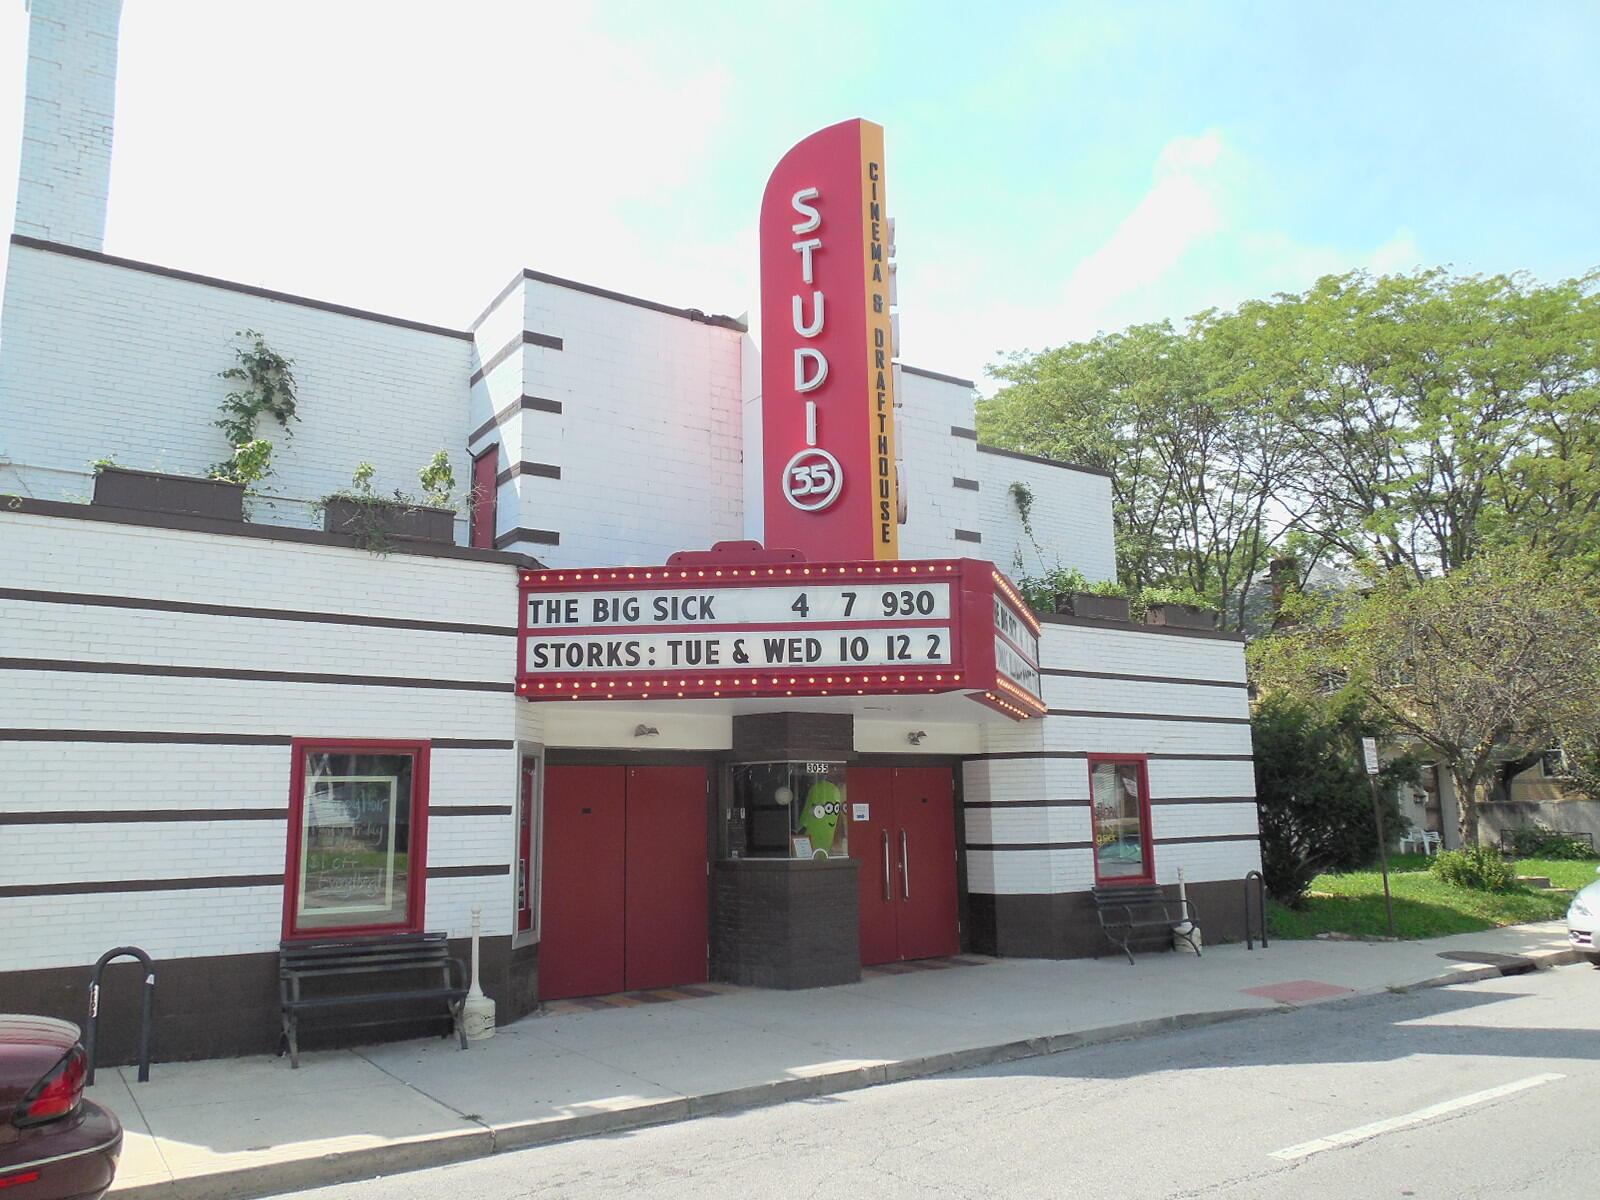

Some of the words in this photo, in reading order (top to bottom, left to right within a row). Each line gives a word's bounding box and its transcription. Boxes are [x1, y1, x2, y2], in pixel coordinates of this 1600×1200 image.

[868, 162, 883, 283] CINEMA
[872, 293, 884, 313] &
[874, 327, 891, 545] DRAFTHOUSE
[790, 463, 833, 497] 35
[528, 599, 579, 624] THE
[592, 597, 640, 623] BIG
[652, 595, 716, 622] SICK
[791, 592, 810, 618] 4
[841, 592, 857, 617] 7
[881, 590, 935, 617] 930
[533, 641, 656, 669] STORKS:
[666, 640, 720, 666] TUE
[732, 638, 750, 664] &
[763, 638, 822, 664] WED
[926, 634, 941, 660] 2
[808, 764, 828, 773] 3055
